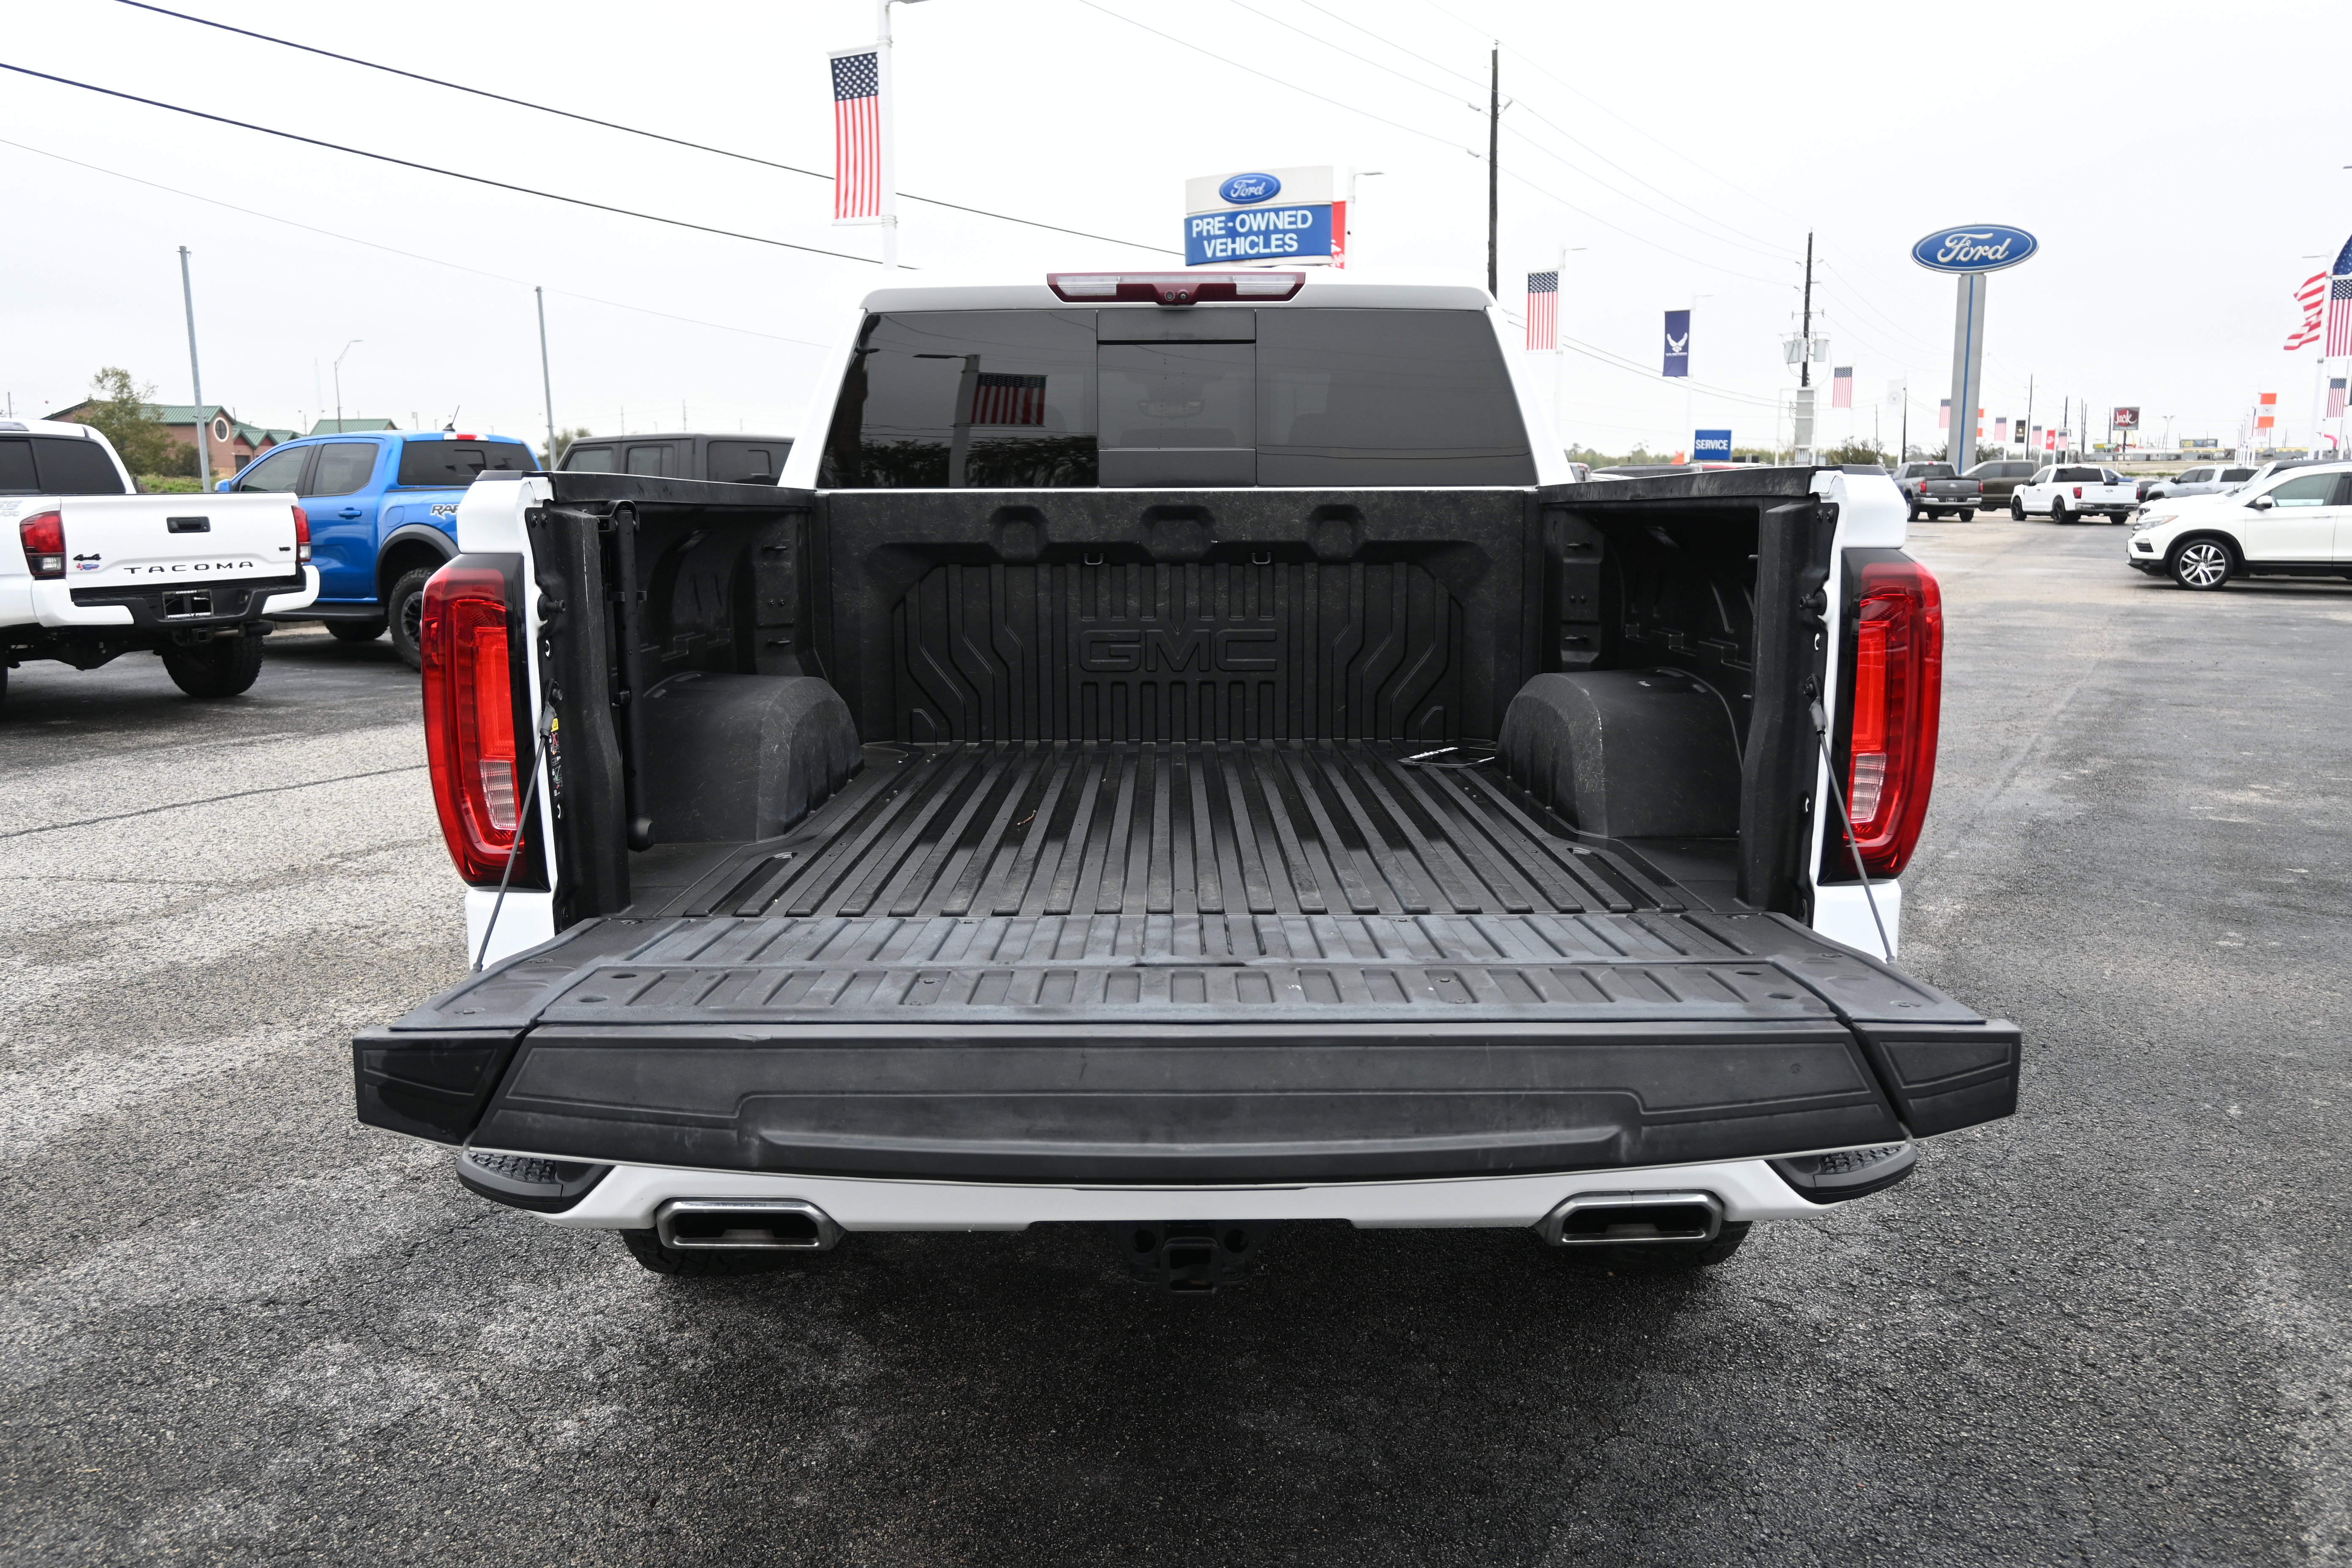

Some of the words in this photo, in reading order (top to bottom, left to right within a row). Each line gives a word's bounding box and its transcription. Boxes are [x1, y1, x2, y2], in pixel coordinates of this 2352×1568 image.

[1230, 179, 1266, 197] Ford
[1192, 210, 1313, 238] PRE-OWNED
[1203, 233, 1298, 258] VEHICLES
[1937, 233, 2012, 263] Ford
[2114, 409, 2137, 425] Jack
[1696, 439, 1729, 450] SERVICE
[123, 561, 253, 574] TACOMA
[1079, 629, 1277, 672] GMC
